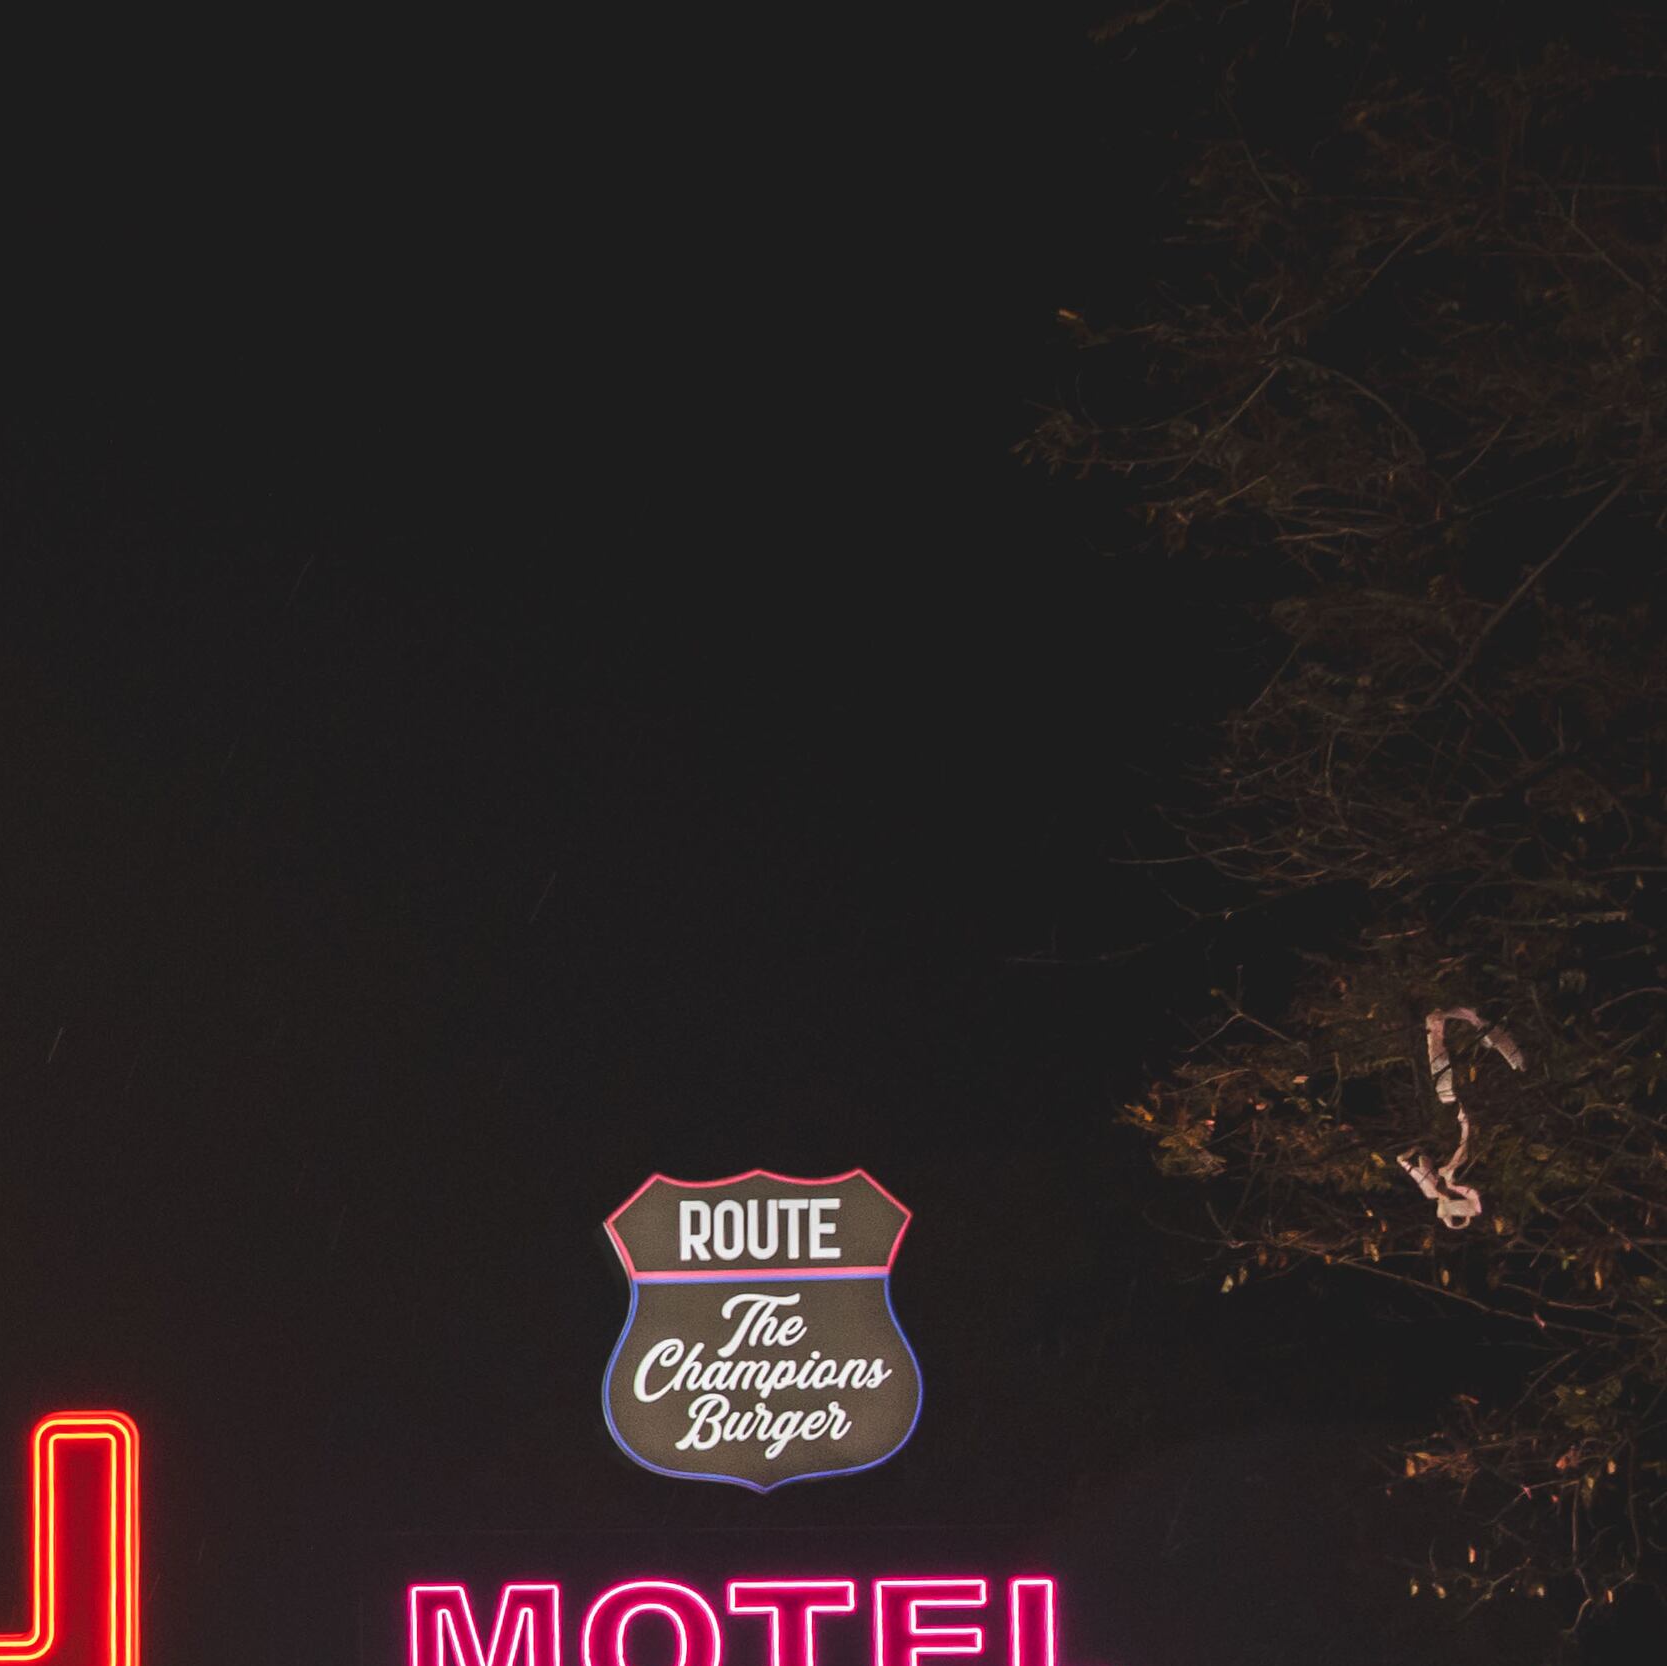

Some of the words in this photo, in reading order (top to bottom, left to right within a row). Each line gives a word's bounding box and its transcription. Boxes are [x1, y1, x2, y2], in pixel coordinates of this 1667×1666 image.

[679, 1197, 841, 1261] ROUTE
[717, 1292, 808, 1358] The
[633, 1338, 892, 1403] Champions
[675, 1393, 852, 1460] Burger
